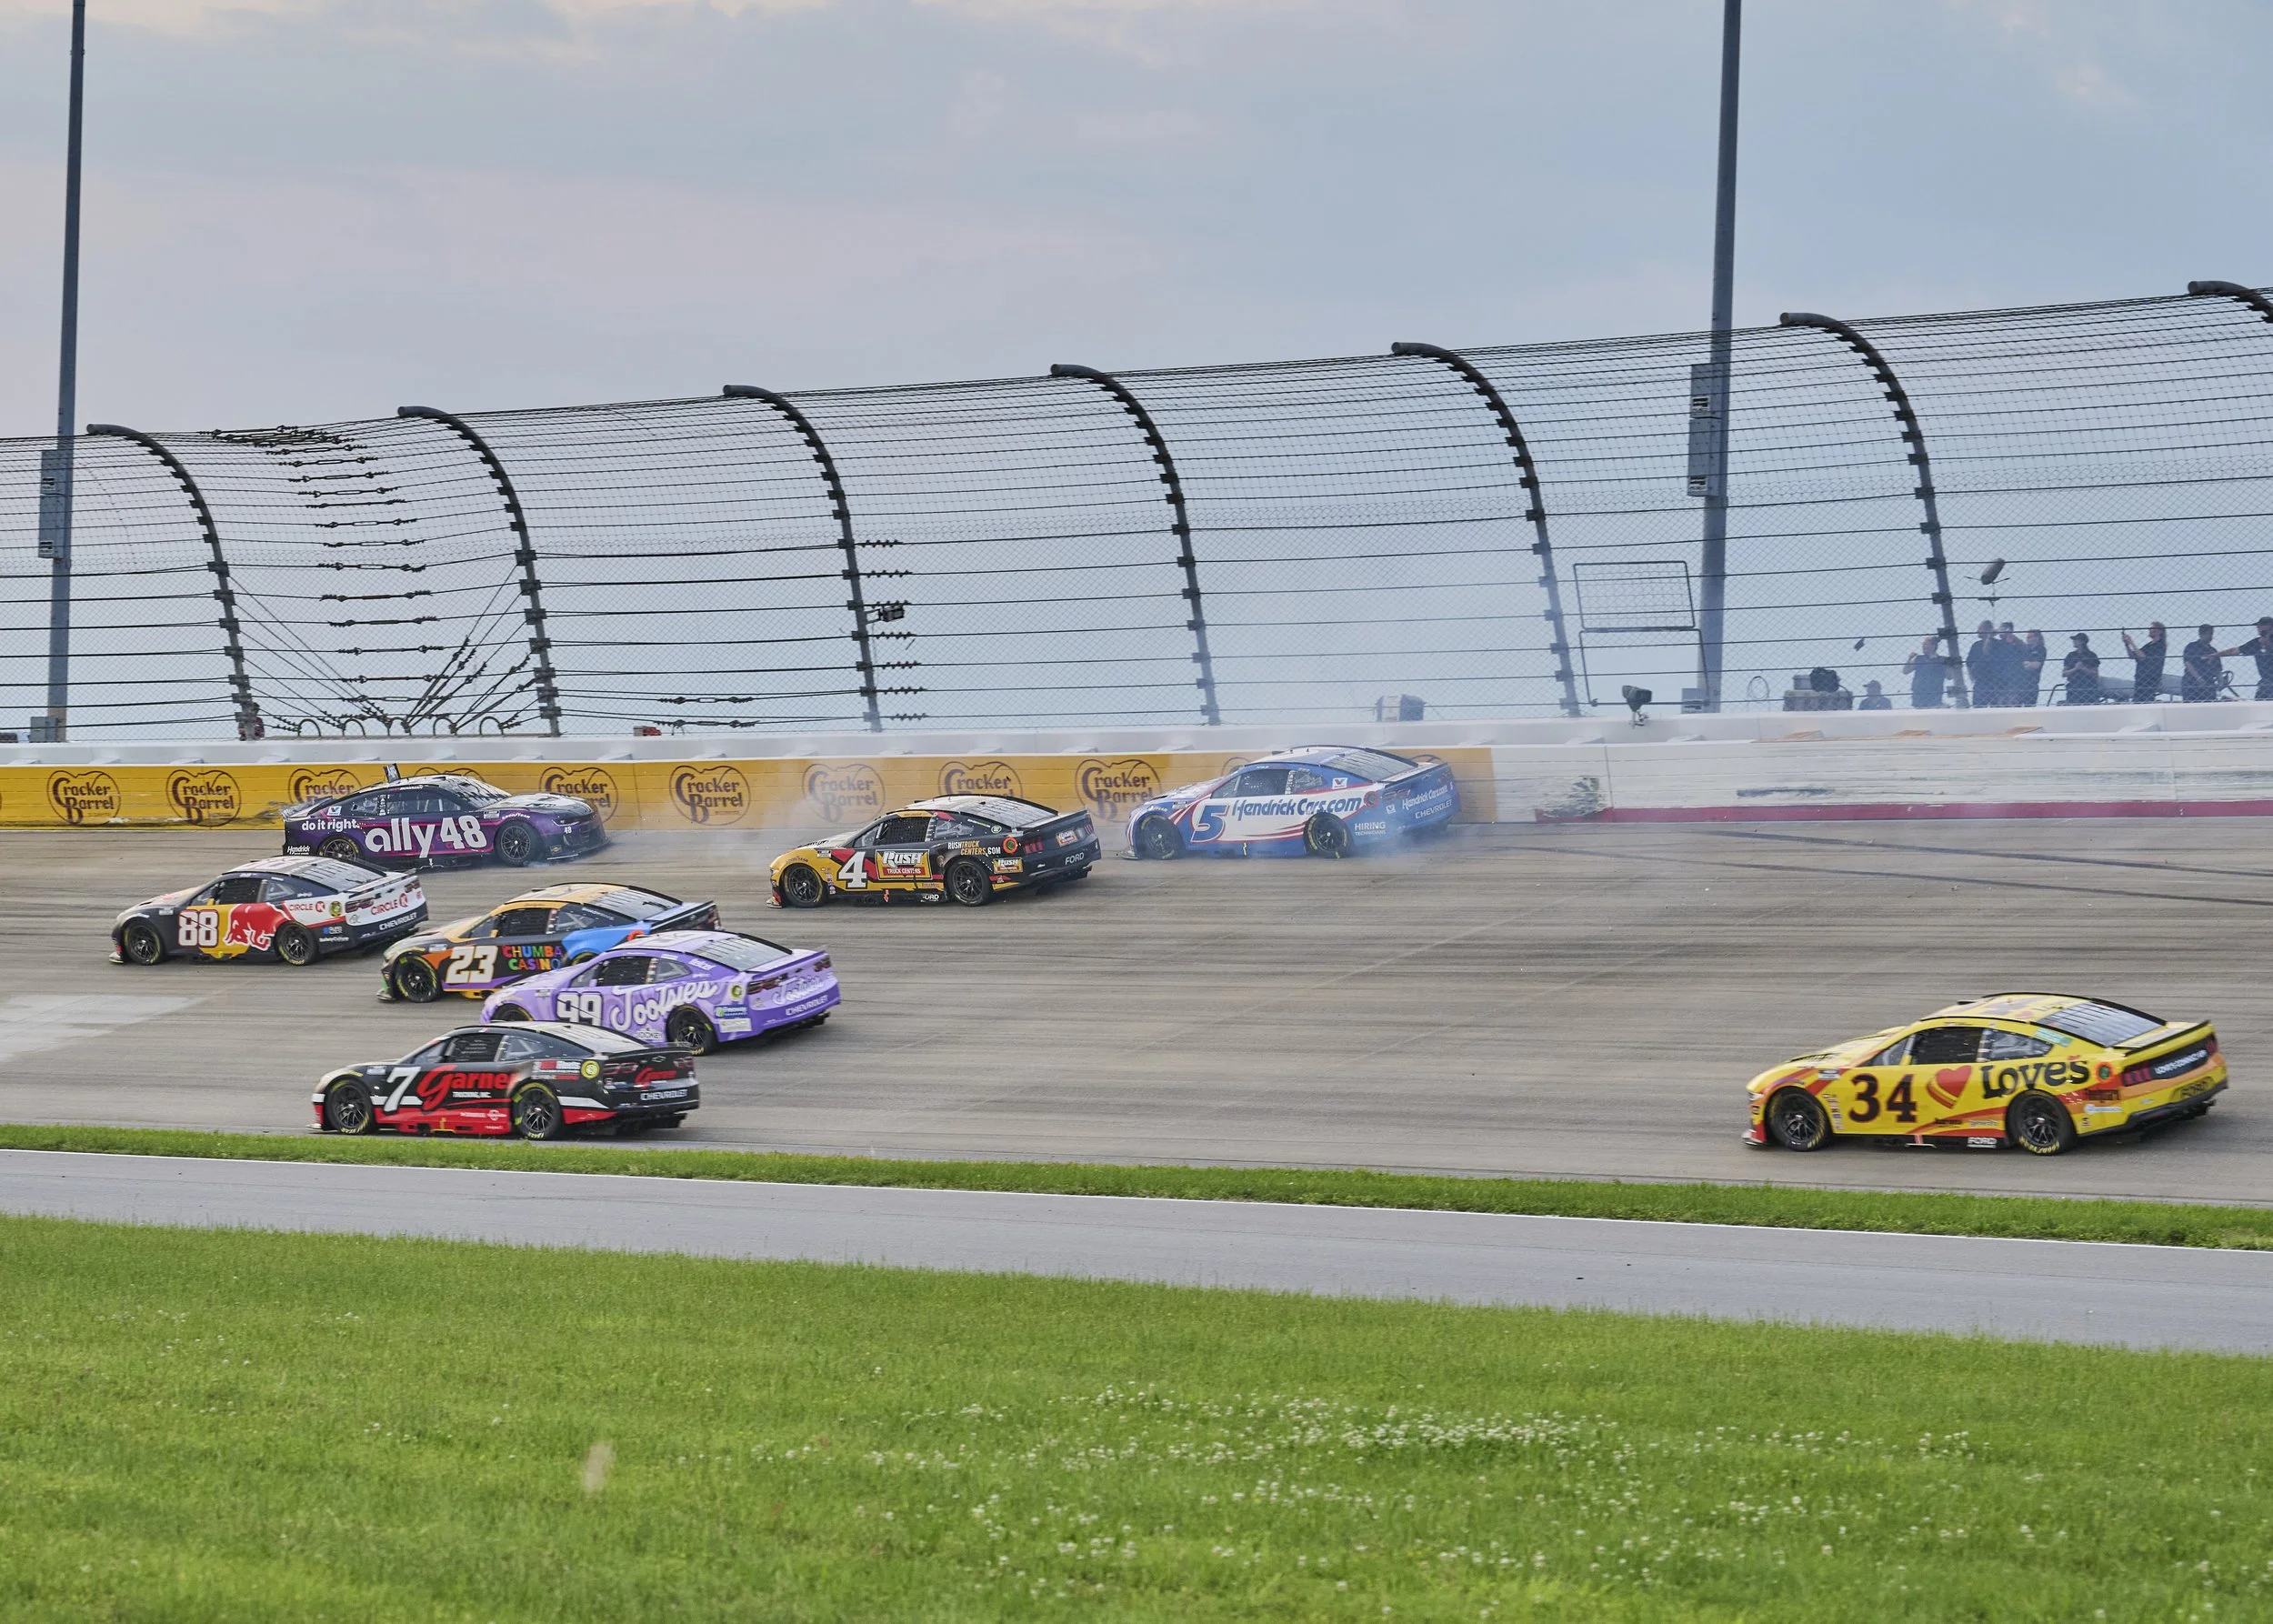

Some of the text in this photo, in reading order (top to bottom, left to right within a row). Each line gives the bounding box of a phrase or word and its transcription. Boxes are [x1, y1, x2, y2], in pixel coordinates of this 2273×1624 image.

[53, 777, 111, 807] Cracker
[173, 777, 231, 807] Cracker
[295, 776, 355, 803] Cracker
[545, 774, 608, 794] Cracker
[676, 773, 740, 807] Cracker
[808, 771, 874, 806] Cracker
[946, 769, 1011, 795] Cracker
[1082, 767, 1150, 801] Cracker
[66, 797, 115, 825] Barrel
[185, 797, 235, 825] Barrel
[689, 793, 743, 823] Barrel
[823, 792, 878, 823] Barrel
[1096, 787, 1153, 820] Barrel
[1415, 799, 1453, 819] CHEVROLET
[302, 821, 315, 831] do
[317, 819, 325, 830] it
[365, 816, 487, 858] ally 48
[564, 826, 572, 834] 48
[1191, 805, 1229, 843] 5
[1355, 821, 1387, 829] HIRING
[287, 846, 310, 855] Hendrick
[1065, 852, 1085, 865] FORD
[838, 851, 867, 888] 4
[289, 901, 325, 912] CIRCLE K
[370, 898, 398, 916] CIRCLE
[178, 910, 219, 947] 88
[379, 912, 417, 930] CHEVROLET
[446, 945, 499, 984] 23
[502, 946, 563, 958] CHUMBA
[508, 958, 562, 971] CASINO
[556, 991, 603, 1027] 99
[786, 995, 828, 1016] CHEVROLET
[383, 1066, 422, 1113] 7
[640, 1088, 688, 1101] CHEVROLET
[1848, 1073, 1918, 1123] 34
